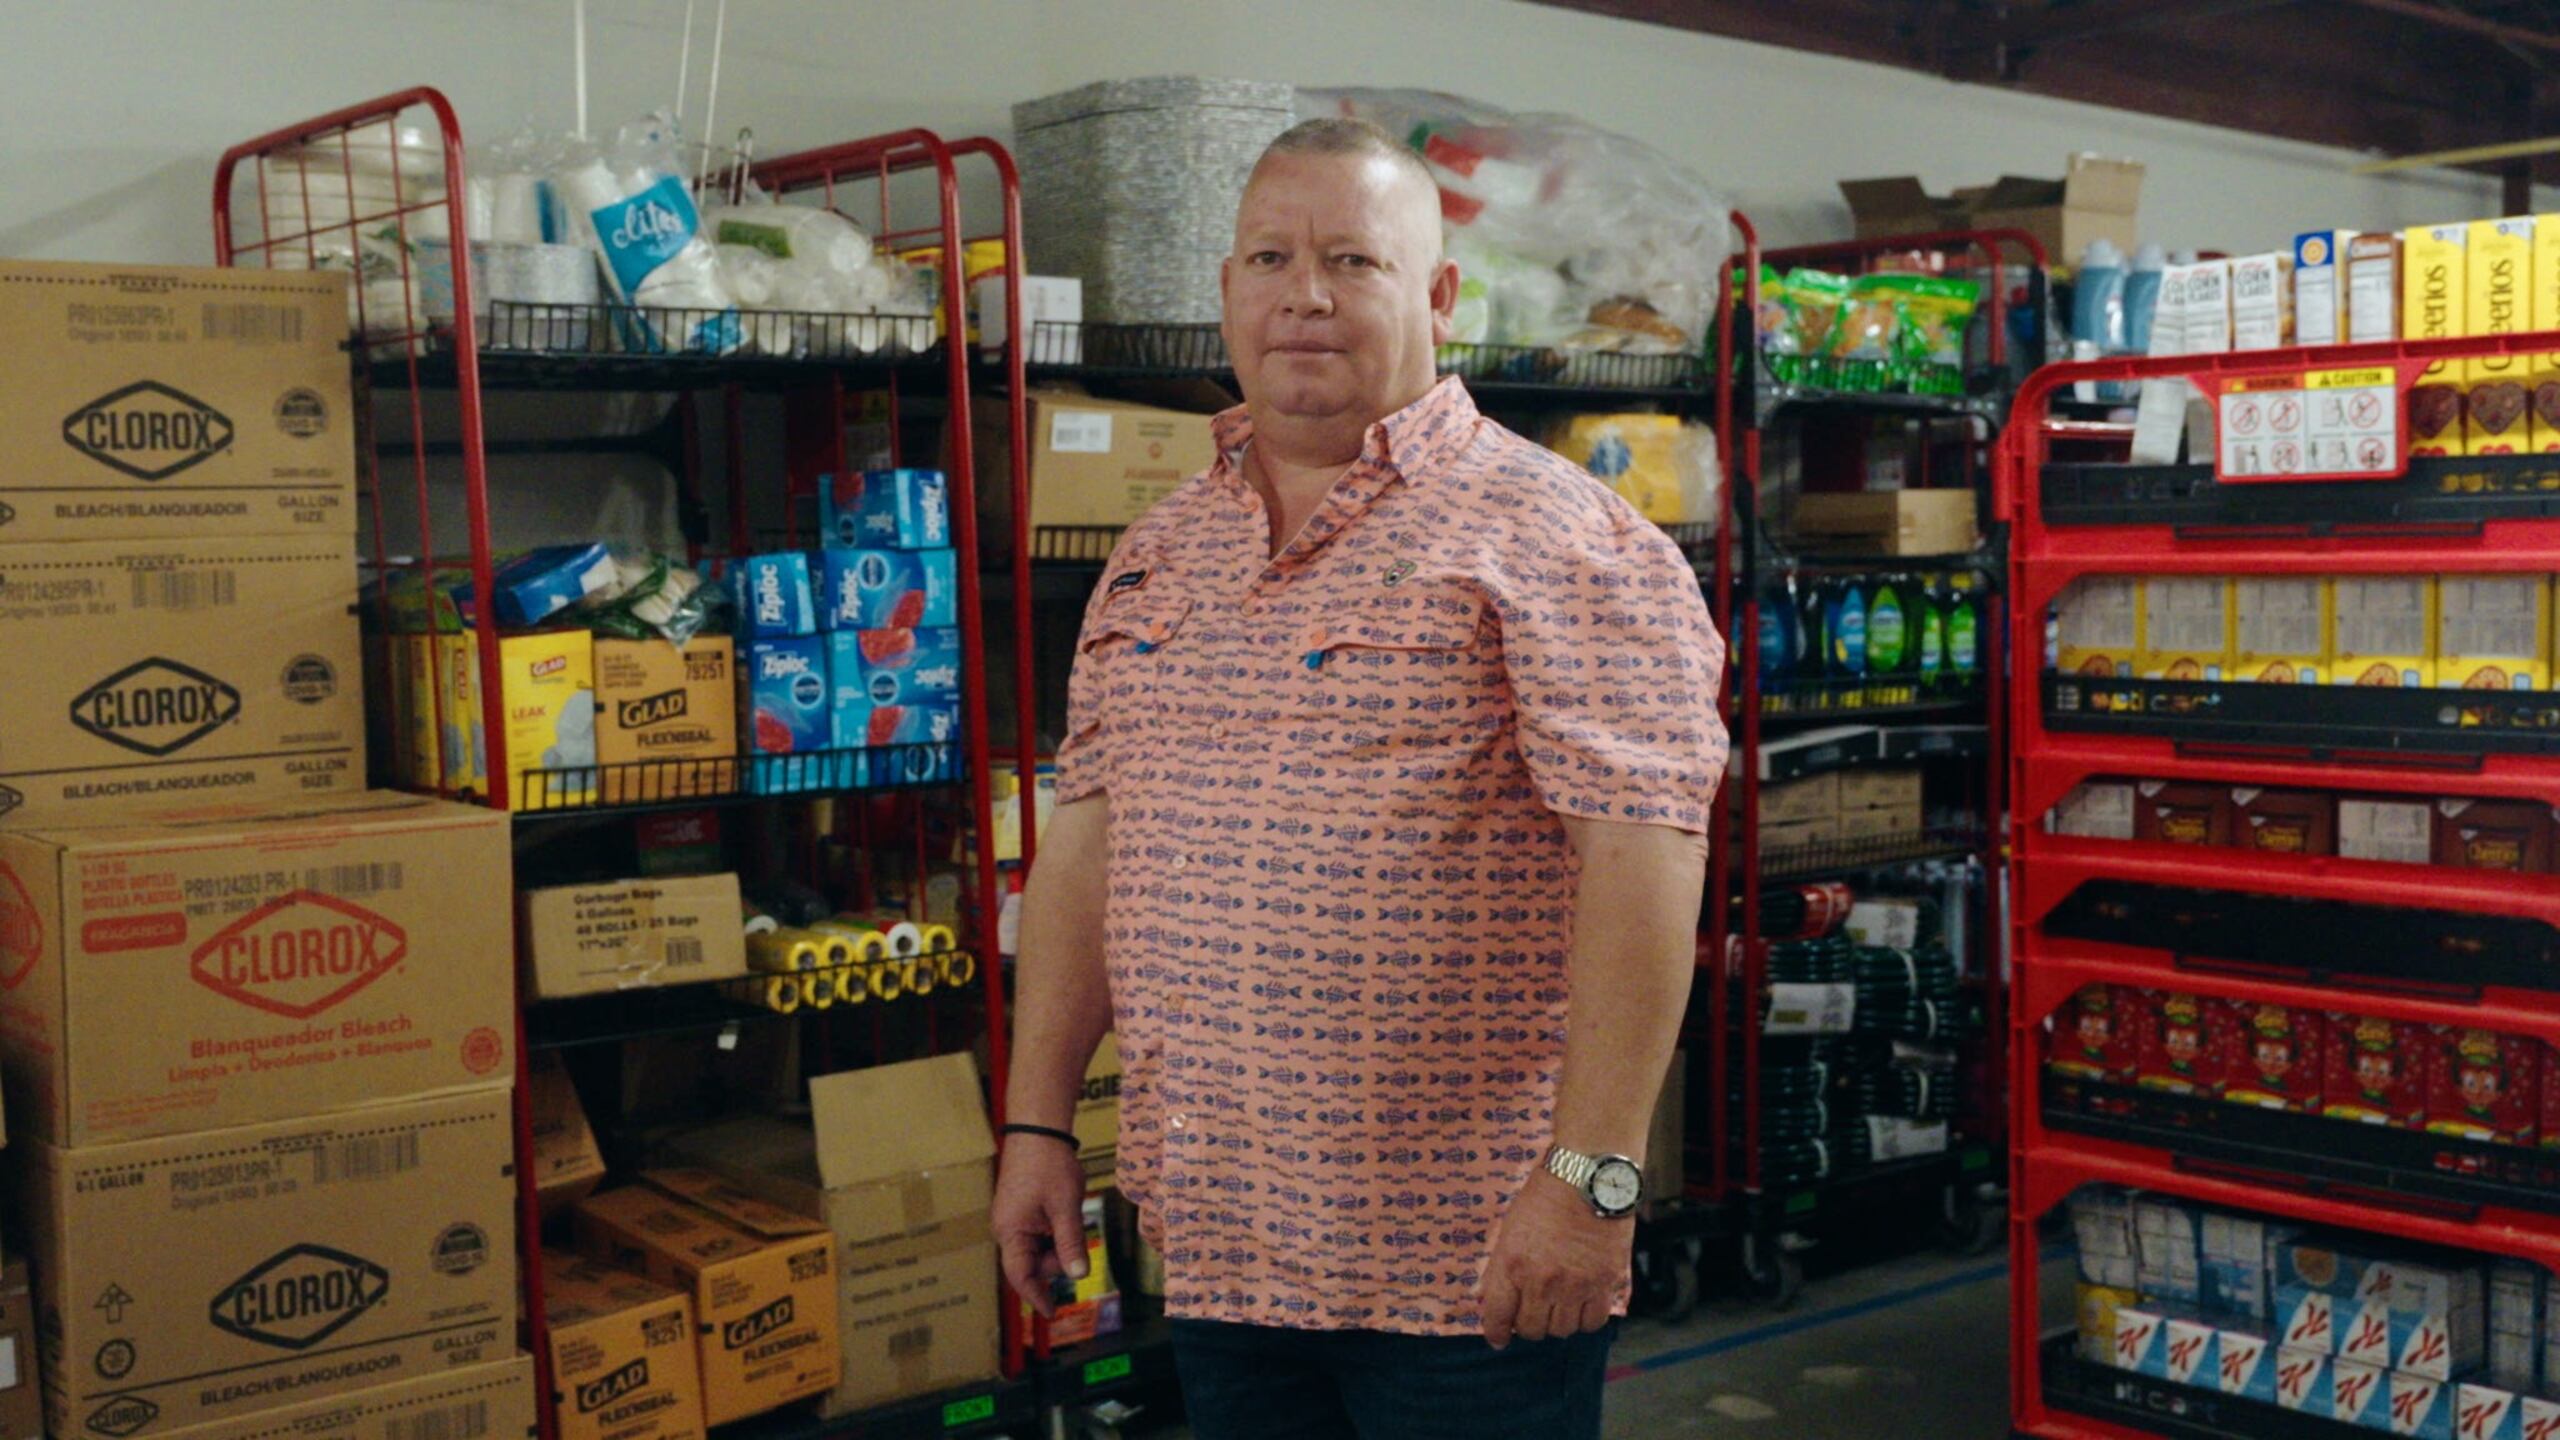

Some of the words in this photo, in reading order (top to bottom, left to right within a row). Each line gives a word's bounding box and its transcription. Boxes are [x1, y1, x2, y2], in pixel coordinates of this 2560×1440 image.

[2334, 371, 2382, 385] CAUTION
[86, 411, 214, 451] CLOROX
[55, 502, 248, 519] BLEACH/BLANQUEADOR
[277, 495, 340, 509] GALLON
[293, 510, 324, 522] SIZE
[761, 563, 785, 621] Ziploc
[764, 655, 809, 679] Ziploc
[93, 685, 221, 730] CLOROX
[512, 705, 546, 720] LEAK
[621, 694, 683, 727] GLAD
[284, 758, 348, 774] GALLON
[62, 771, 257, 800] BLEACH/BLANQUEADOR
[300, 774, 334, 788] SIZE
[632, 888, 664, 900] Bags
[596, 919, 638, 933] ROLLS
[219, 922, 383, 988] CLOROX
[190, 1025, 336, 1060] Blanqueador
[340, 1015, 414, 1040] Bleach
[98, 1171, 144, 1191] GALLON
[233, 1266, 369, 1329] CLOROX
[728, 1301, 791, 1346] GLAD
[431, 1330, 498, 1352] GALLON
[2117, 1325, 2150, 1361] K
[2169, 1336, 2203, 1373] K
[2222, 1348, 2256, 1386] K
[446, 1348, 483, 1364] SIZE
[200, 1353, 402, 1405] BLEACH/BLANQUEADOR
[582, 1365, 646, 1408] GLAD
[2279, 1359, 2316, 1398] K
[2337, 1373, 2373, 1413] K
[2392, 1386, 2431, 1427] K
[2460, 1399, 2503, 1440] K
